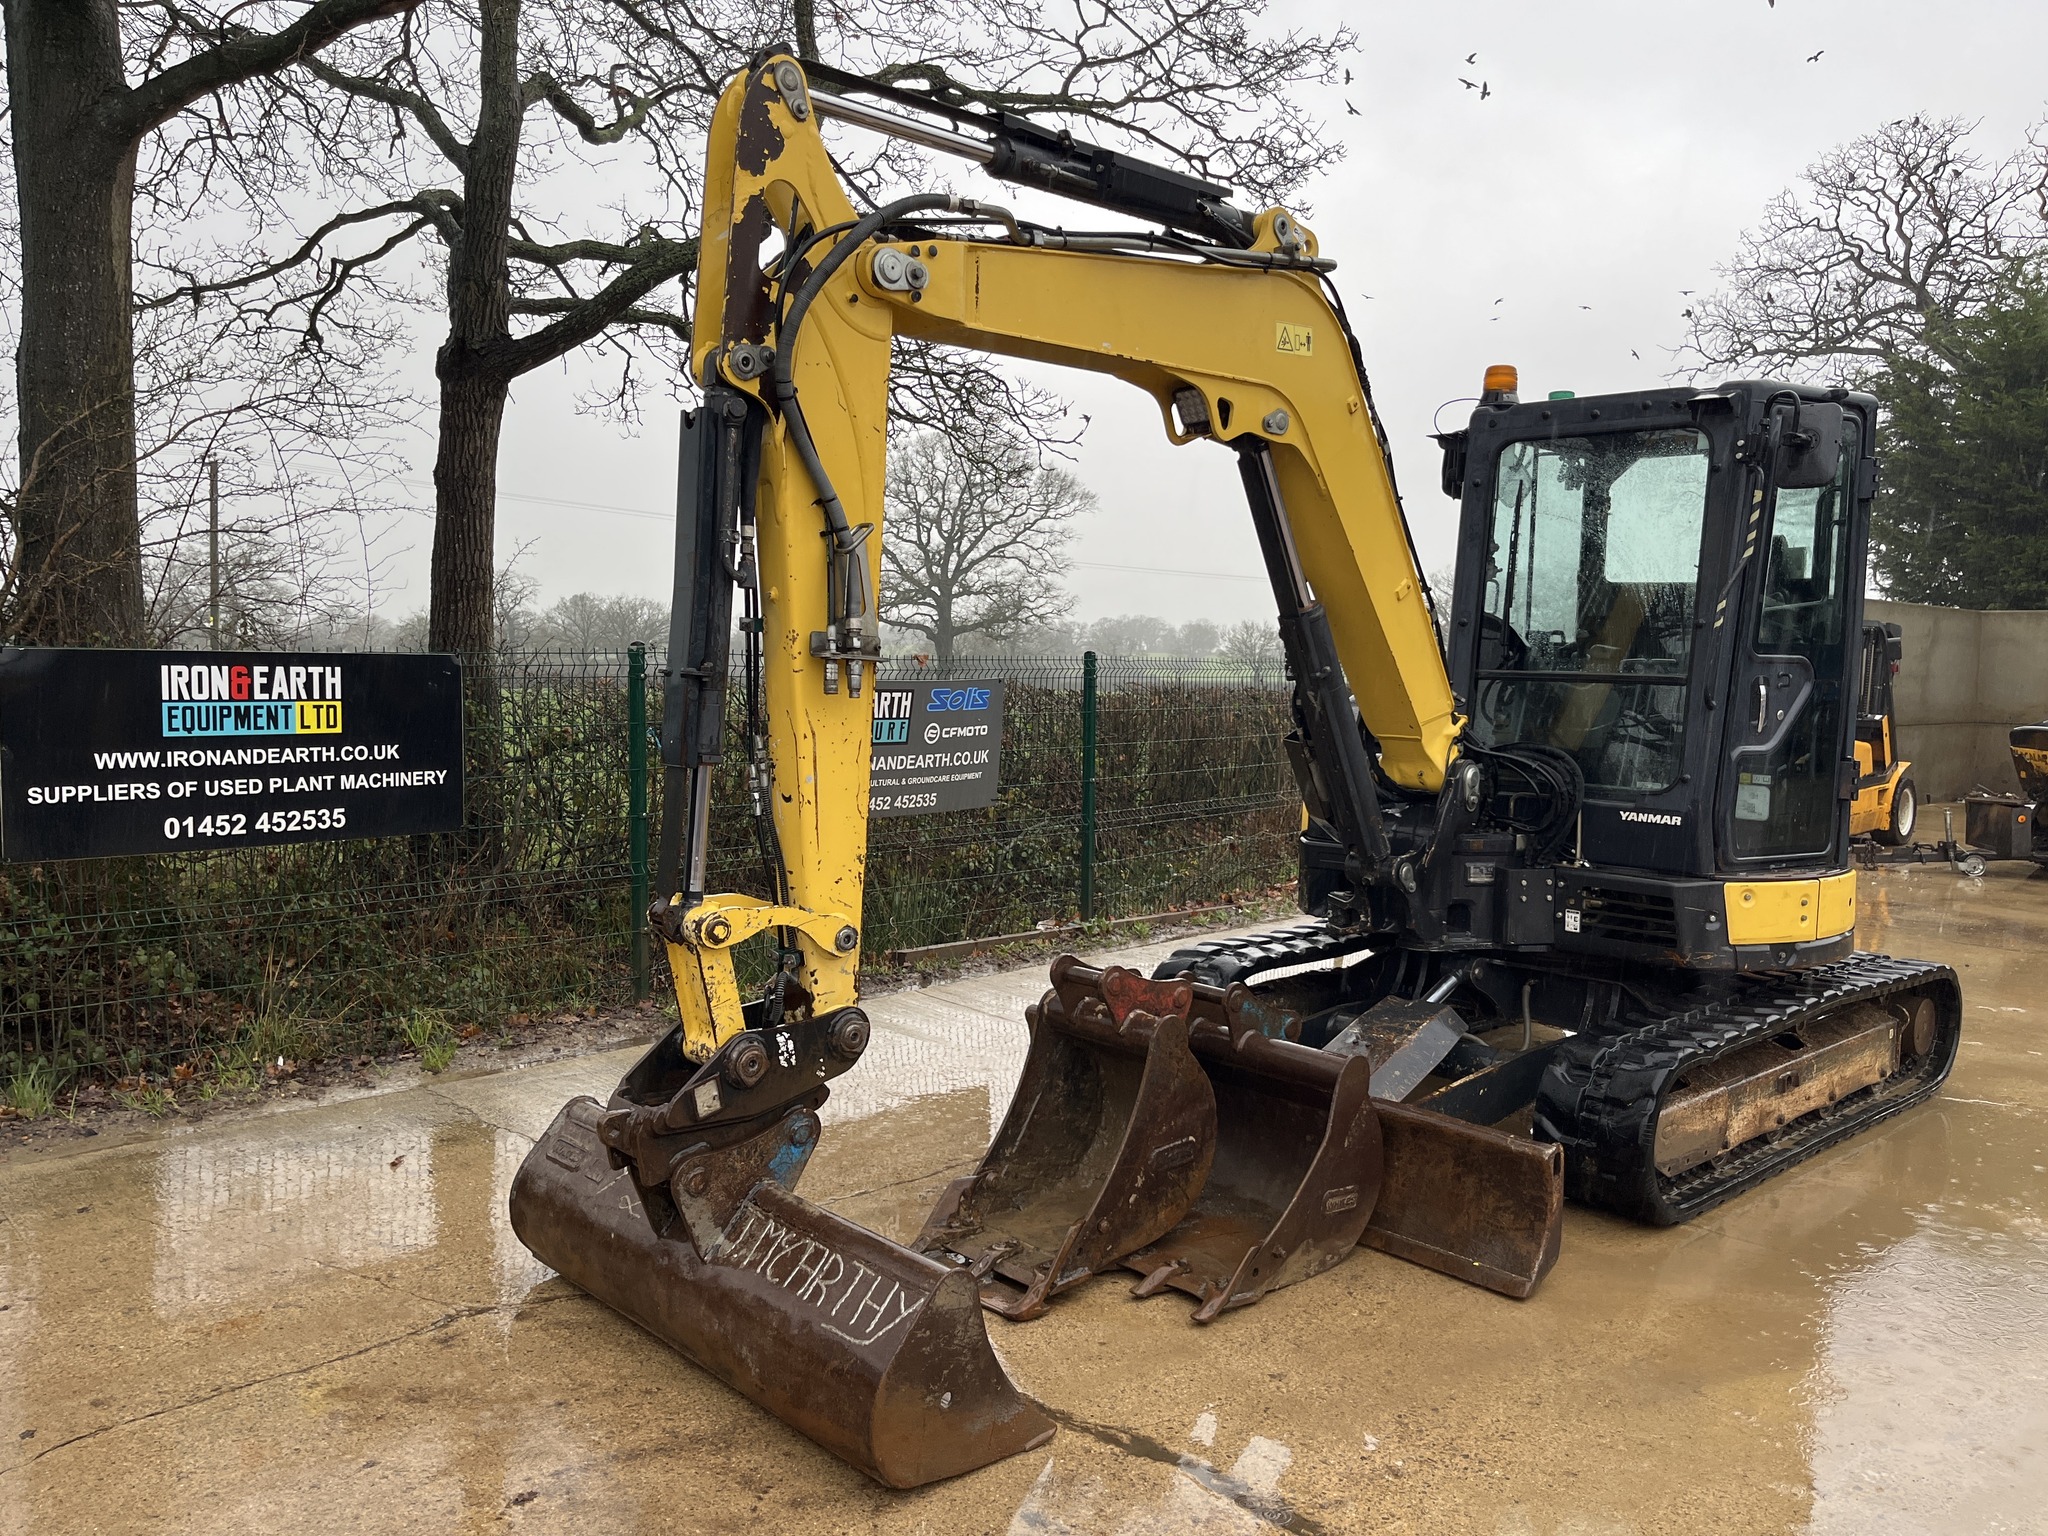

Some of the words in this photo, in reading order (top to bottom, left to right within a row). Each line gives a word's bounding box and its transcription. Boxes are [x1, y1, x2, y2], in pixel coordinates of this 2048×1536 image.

[167, 705, 292, 734] EQUIPMENT
[300, 704, 338, 729] LTD
[942, 725, 988, 738] CFMOTO
[94, 744, 400, 770] WWW.IRONANDEARTH.CO.UK
[27, 782, 161, 805] SUPPLIERS
[167, 780, 199, 799] OF
[204, 778, 263, 797] USED
[269, 776, 335, 794] PLANT
[340, 769, 448, 790] MACHINERY
[901, 777, 907, 786] &
[908, 776, 950, 785] GROUNDCARE
[951, 772, 982, 782] EQUIPMENT
[894, 793, 937, 808] 452535
[164, 813, 247, 840] 01452
[255, 807, 346, 833] 452535
[1619, 811, 1682, 826] YANMAR
